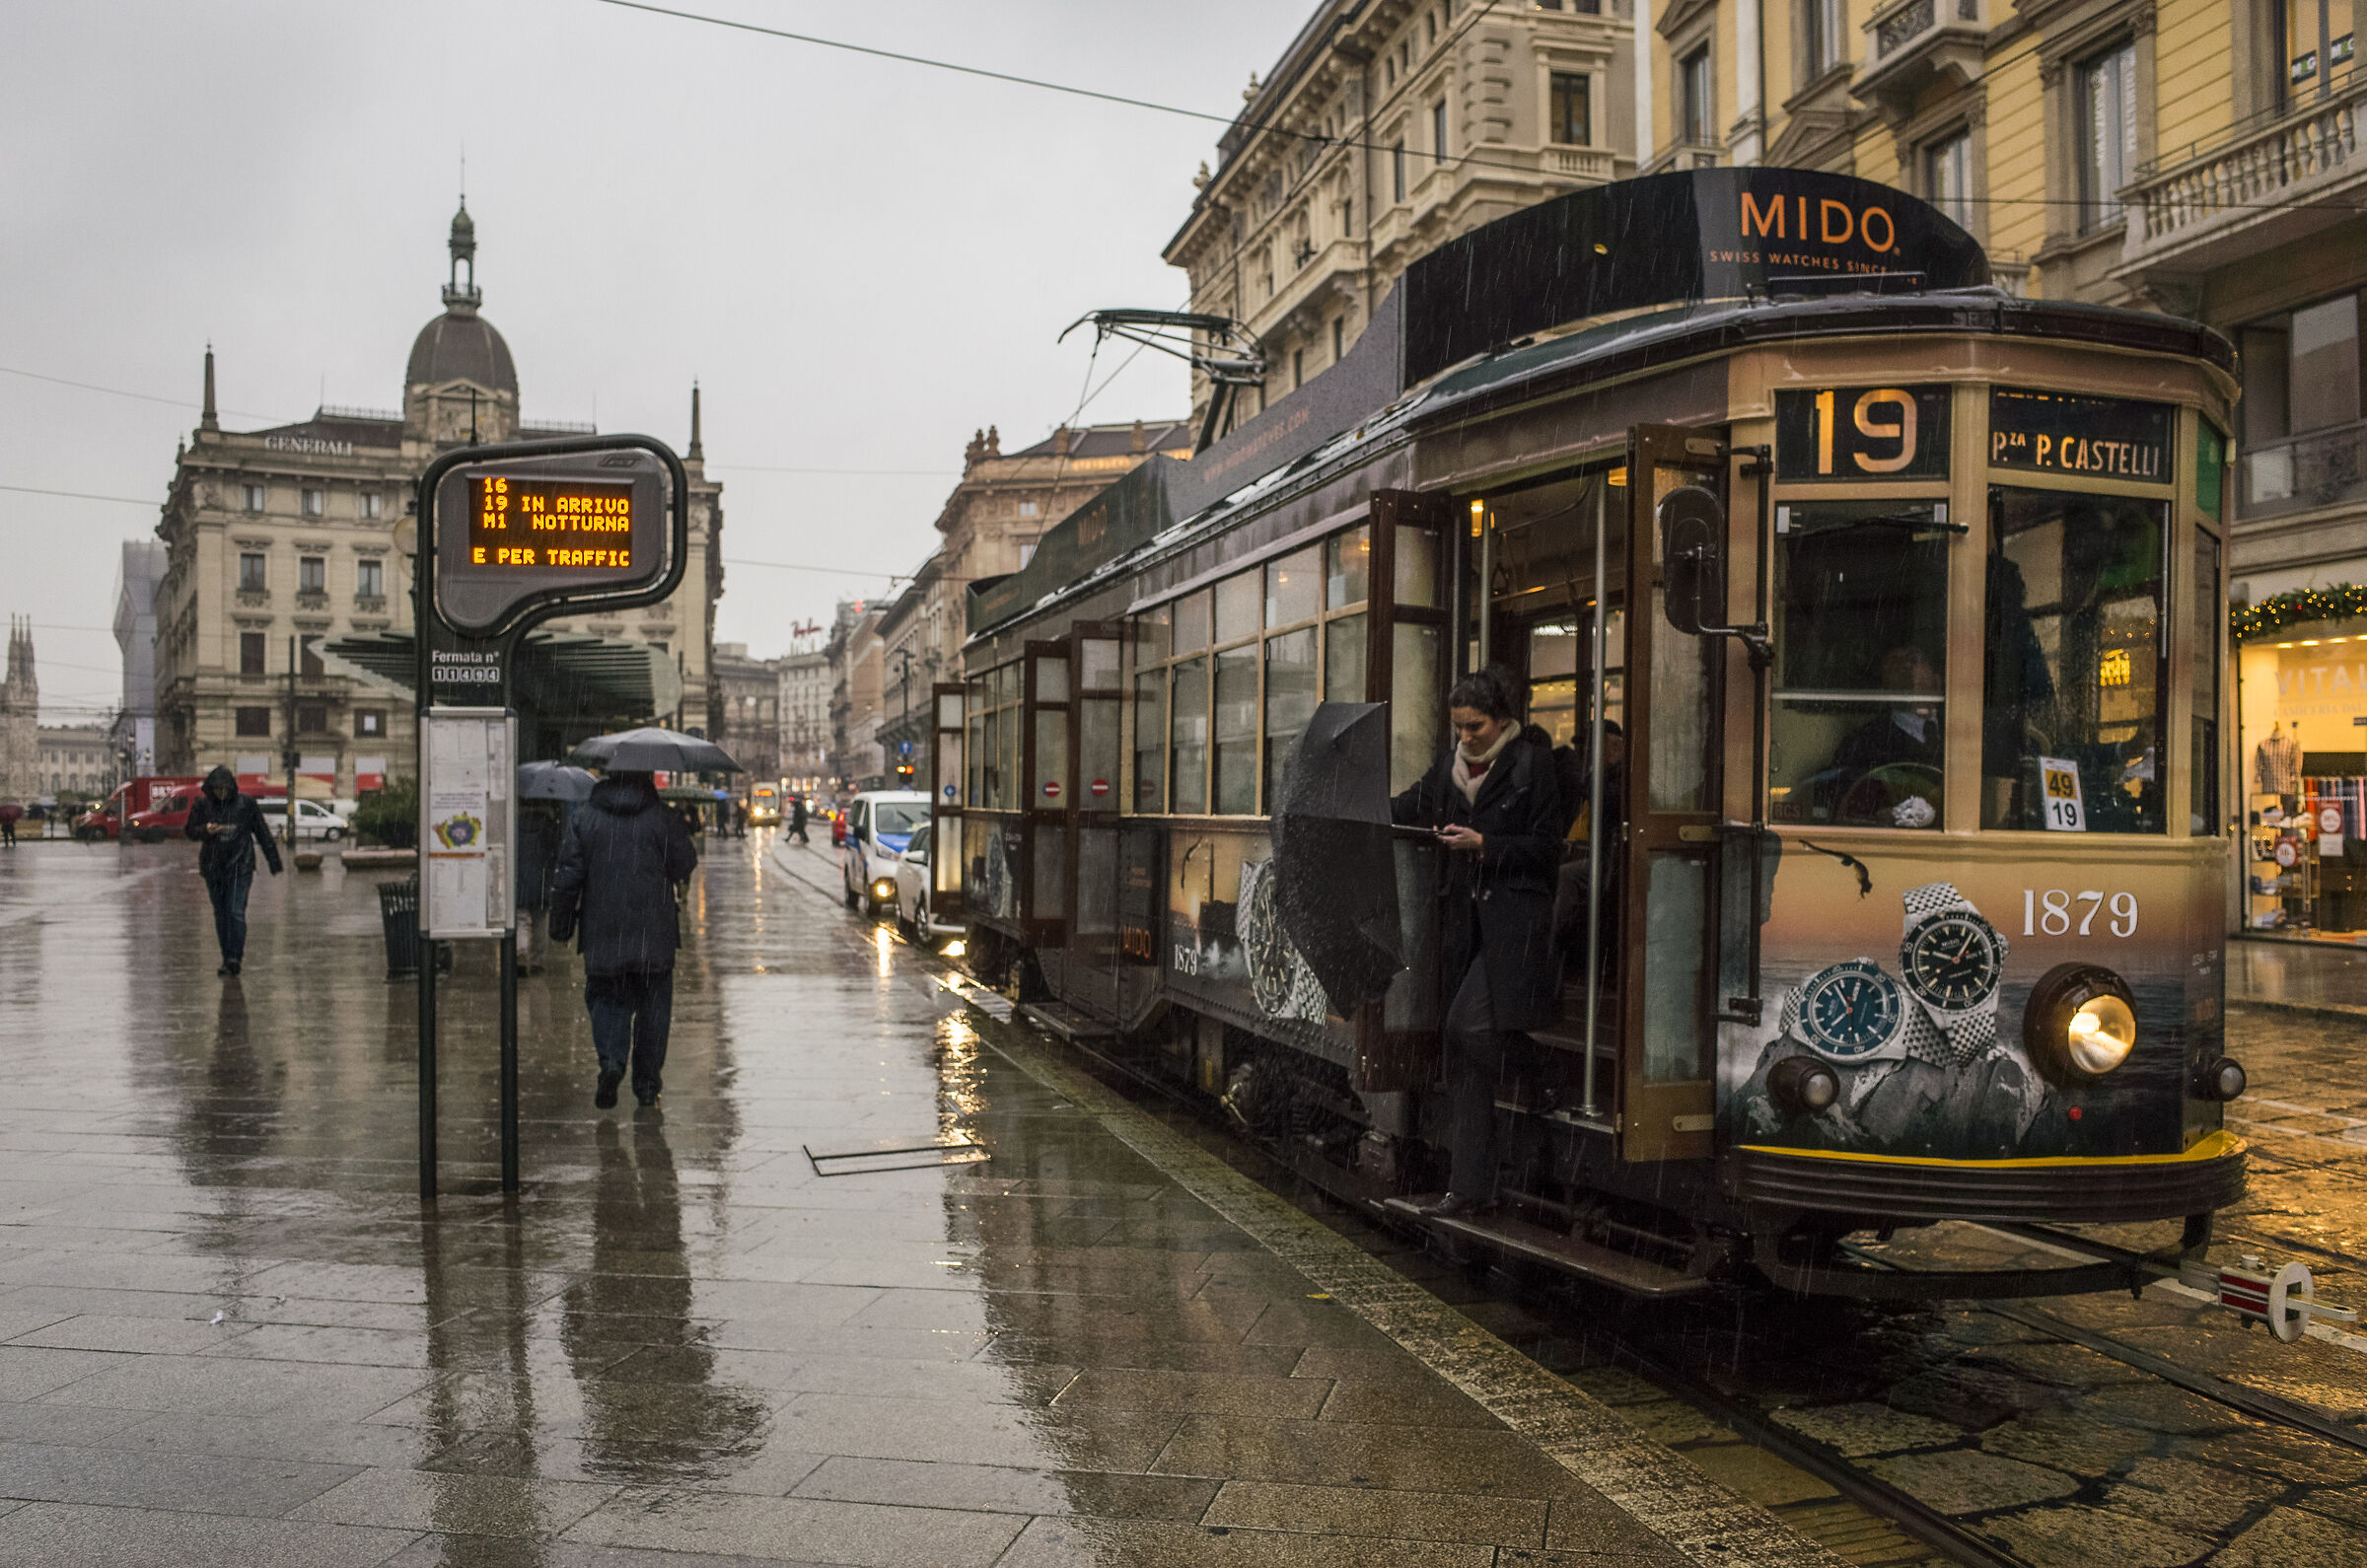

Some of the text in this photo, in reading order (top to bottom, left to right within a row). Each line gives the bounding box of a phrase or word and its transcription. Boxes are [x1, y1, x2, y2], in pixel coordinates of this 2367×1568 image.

[1741, 192, 1896, 252] MIDO
[1709, 249, 1760, 263] SWISS
[1768, 252, 1840, 271] WATCHES
[1815, 388, 1917, 475] 19
[264, 436, 353, 456] GENERALI
[2036, 433, 2052, 466] P.
[2059, 436, 2160, 476] CASTELLI
[484, 477, 508, 493] 16
[484, 495, 629, 515] 19 IN ARRIVO
[483, 513, 629, 532] M1 NOTTURNA
[472, 547, 630, 567] E PER TRAFFIC
[432, 650, 482, 663] Fermata
[2047, 773, 2075, 798] 49
[2051, 802, 2078, 827] 19
[2022, 890, 2139, 938] 1879
[1174, 944, 1197, 976] 1879
